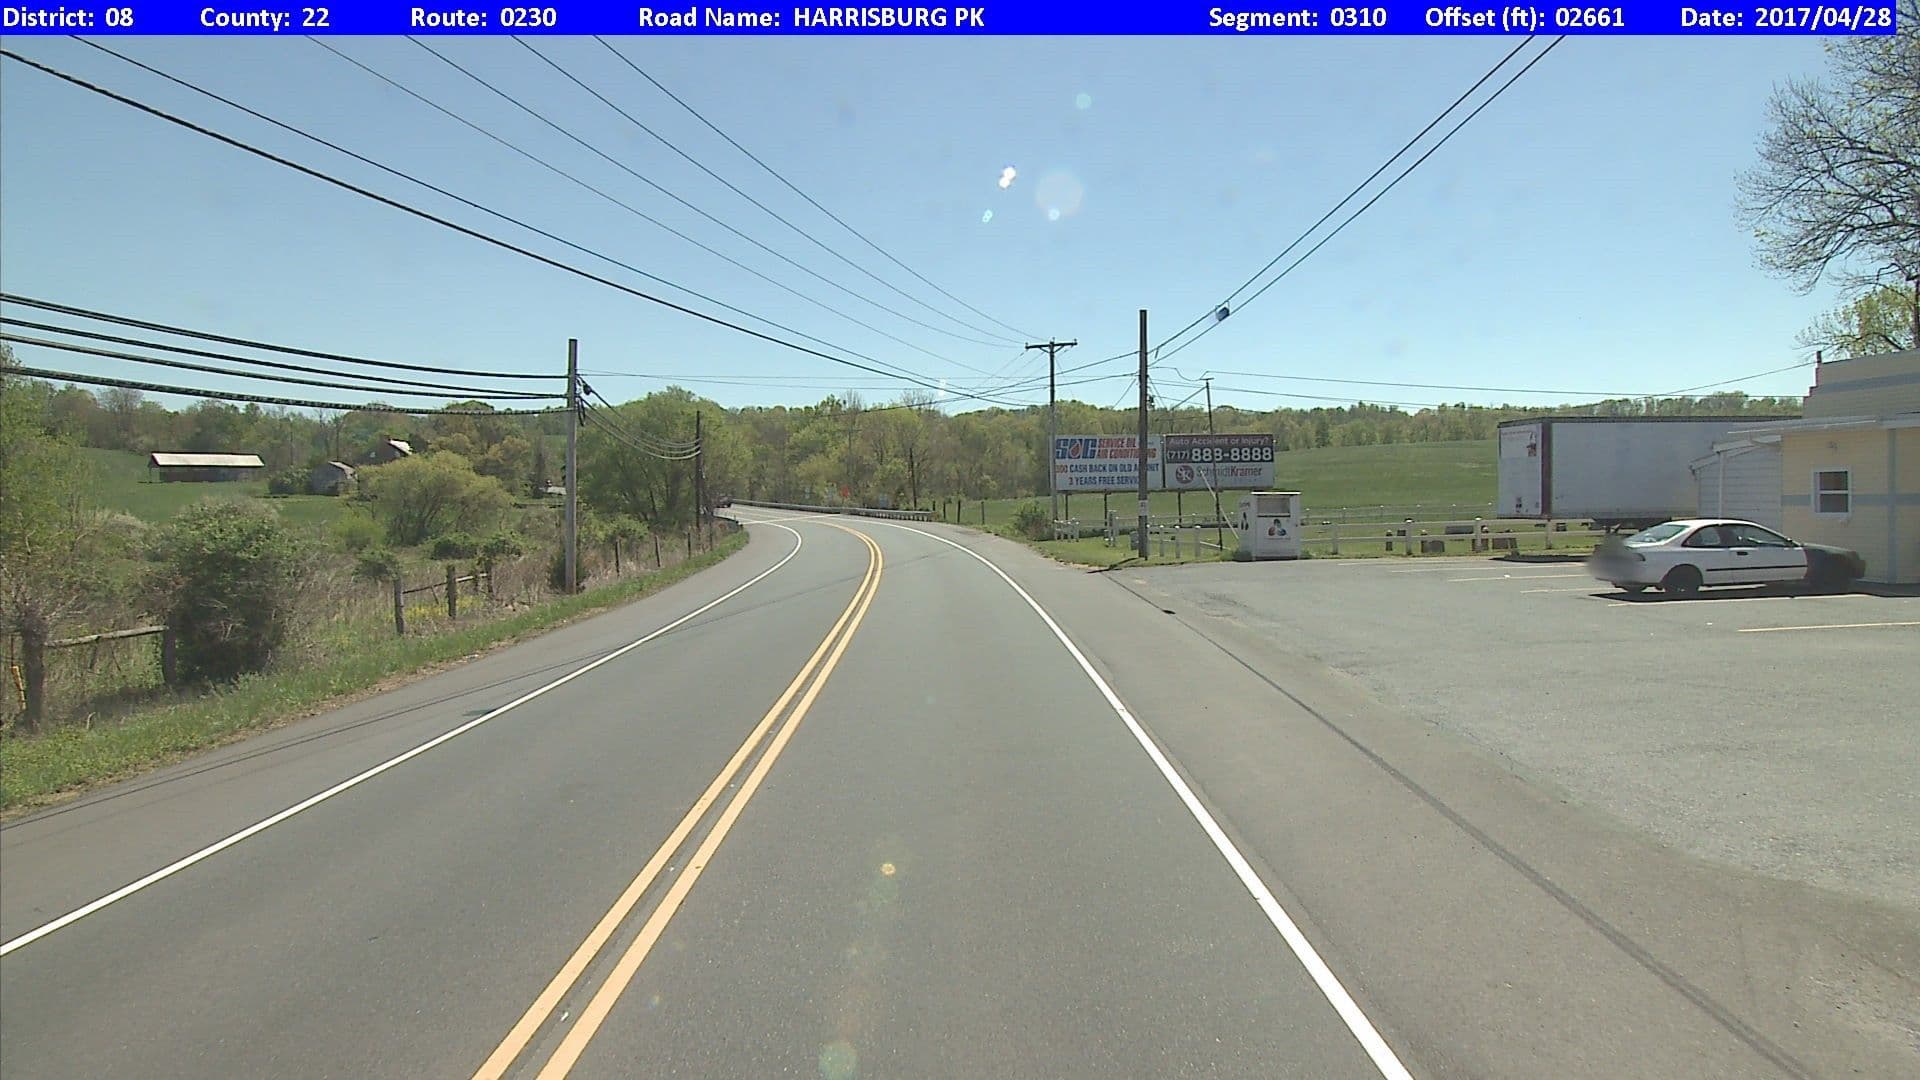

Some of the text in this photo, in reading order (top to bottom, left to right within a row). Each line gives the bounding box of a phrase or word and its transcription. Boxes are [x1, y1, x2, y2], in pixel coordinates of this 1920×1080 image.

[1241, 437, 1269, 446] Injury?
[1167, 447, 1272, 462] (717) 888-8888
[1069, 463, 1087, 473] CASH
[1088, 463, 1107, 473] BACK
[1108, 463, 1118, 473] ON
[1119, 463, 1133, 473] OLD
[1075, 477, 1097, 486] YEARS
[1098, 476, 1115, 485] FREE
